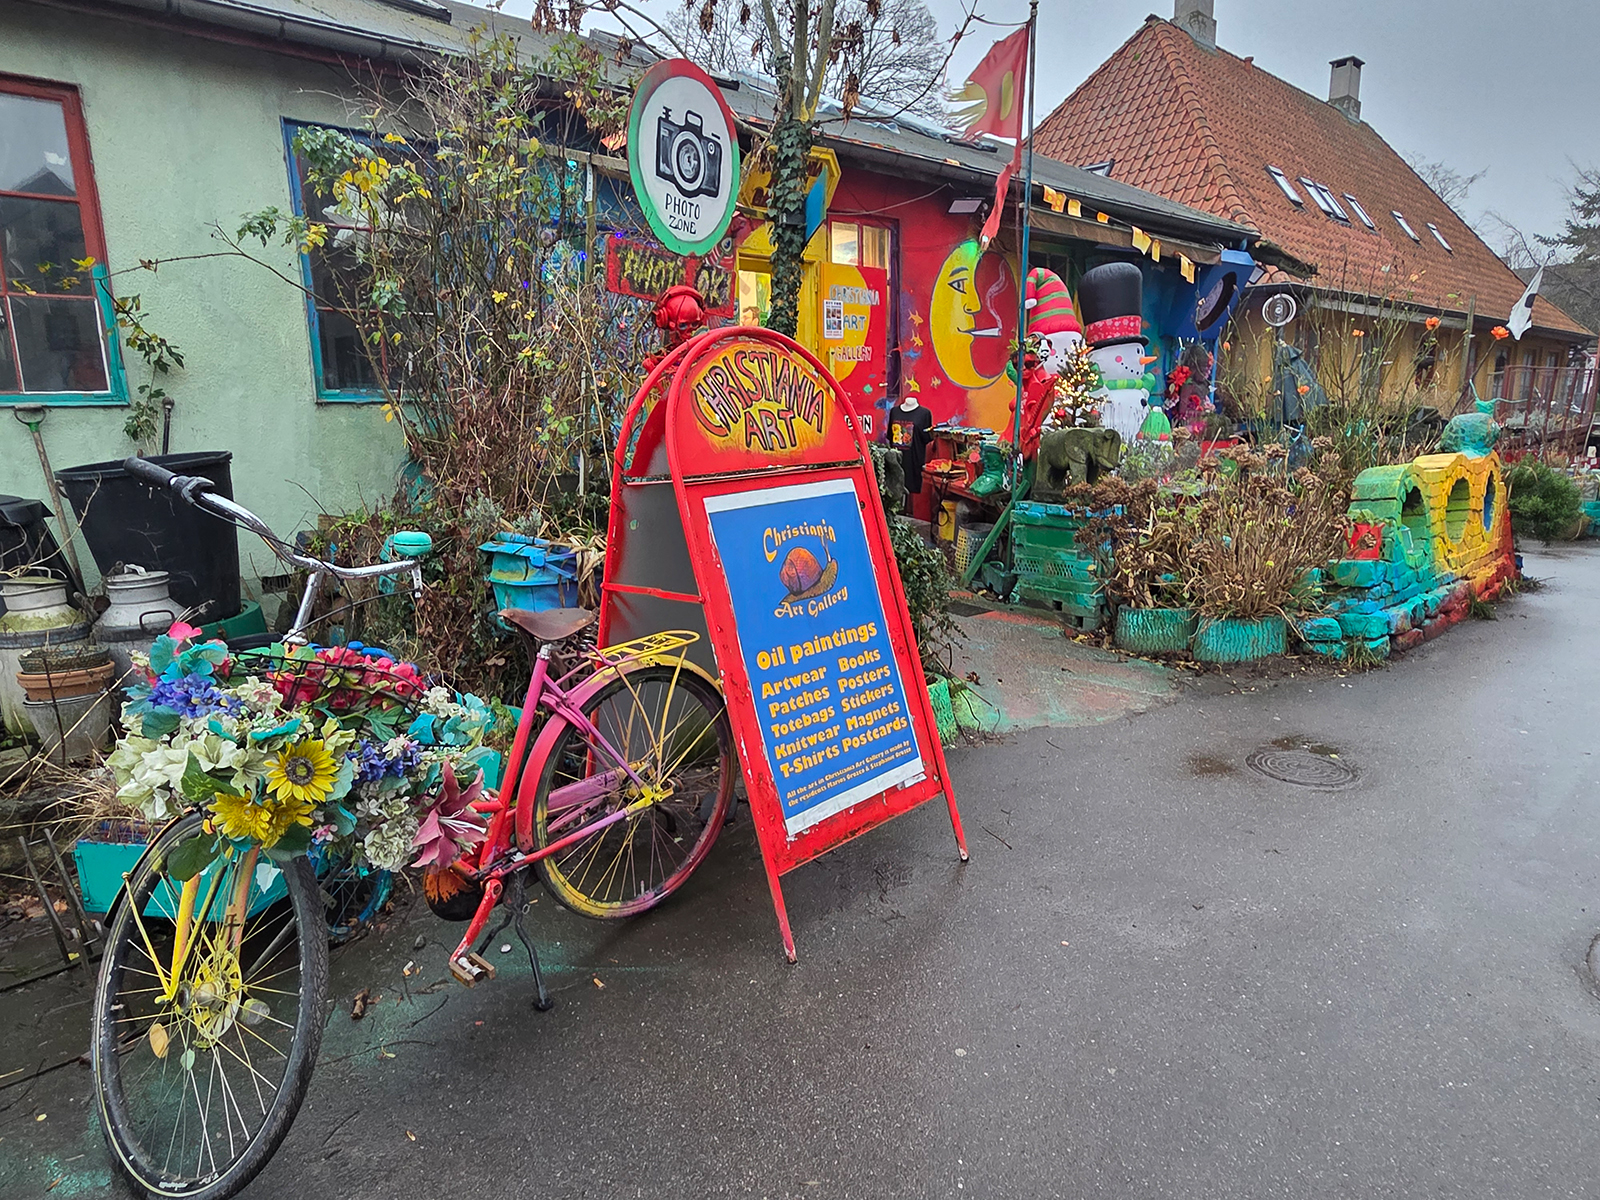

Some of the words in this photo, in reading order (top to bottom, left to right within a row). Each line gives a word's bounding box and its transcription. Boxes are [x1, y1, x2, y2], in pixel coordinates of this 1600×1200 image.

[665, 193, 700, 220] PHOTO
[669, 215, 696, 234] ZONE
[843, 315, 866, 331] ART
[835, 346, 872, 361] GALLERY
[691, 350, 824, 437] CHRISTIANIA
[744, 409, 797, 451] ART
[763, 518, 836, 564] Christiania
[773, 601, 804, 618] Art
[807, 586, 848, 618] Gallery
[756, 645, 786, 670] Oil
[789, 621, 878, 665] paintings
[761, 666, 827, 699] Artwear
[837, 648, 881, 673] Books
[768, 685, 830, 718] Patches
[837, 664, 891, 693] Posters
[770, 705, 836, 738] Totebags
[840, 683, 895, 713] Stickers
[774, 724, 840, 760] Knitwear
[845, 701, 900, 732] Magnets
[780, 744, 840, 778] T-Shirts
[841, 716, 908, 753] Postcards
[786, 790, 796, 799] All
[796, 786, 807, 795] the
[807, 781, 818, 789] art
[824, 765, 855, 781] Christiania
[855, 760, 865, 768] Art
[865, 752, 884, 763] Gallery
[889, 743, 903, 752] made
[788, 798, 799, 807] the
[799, 786, 827, 801] residents
